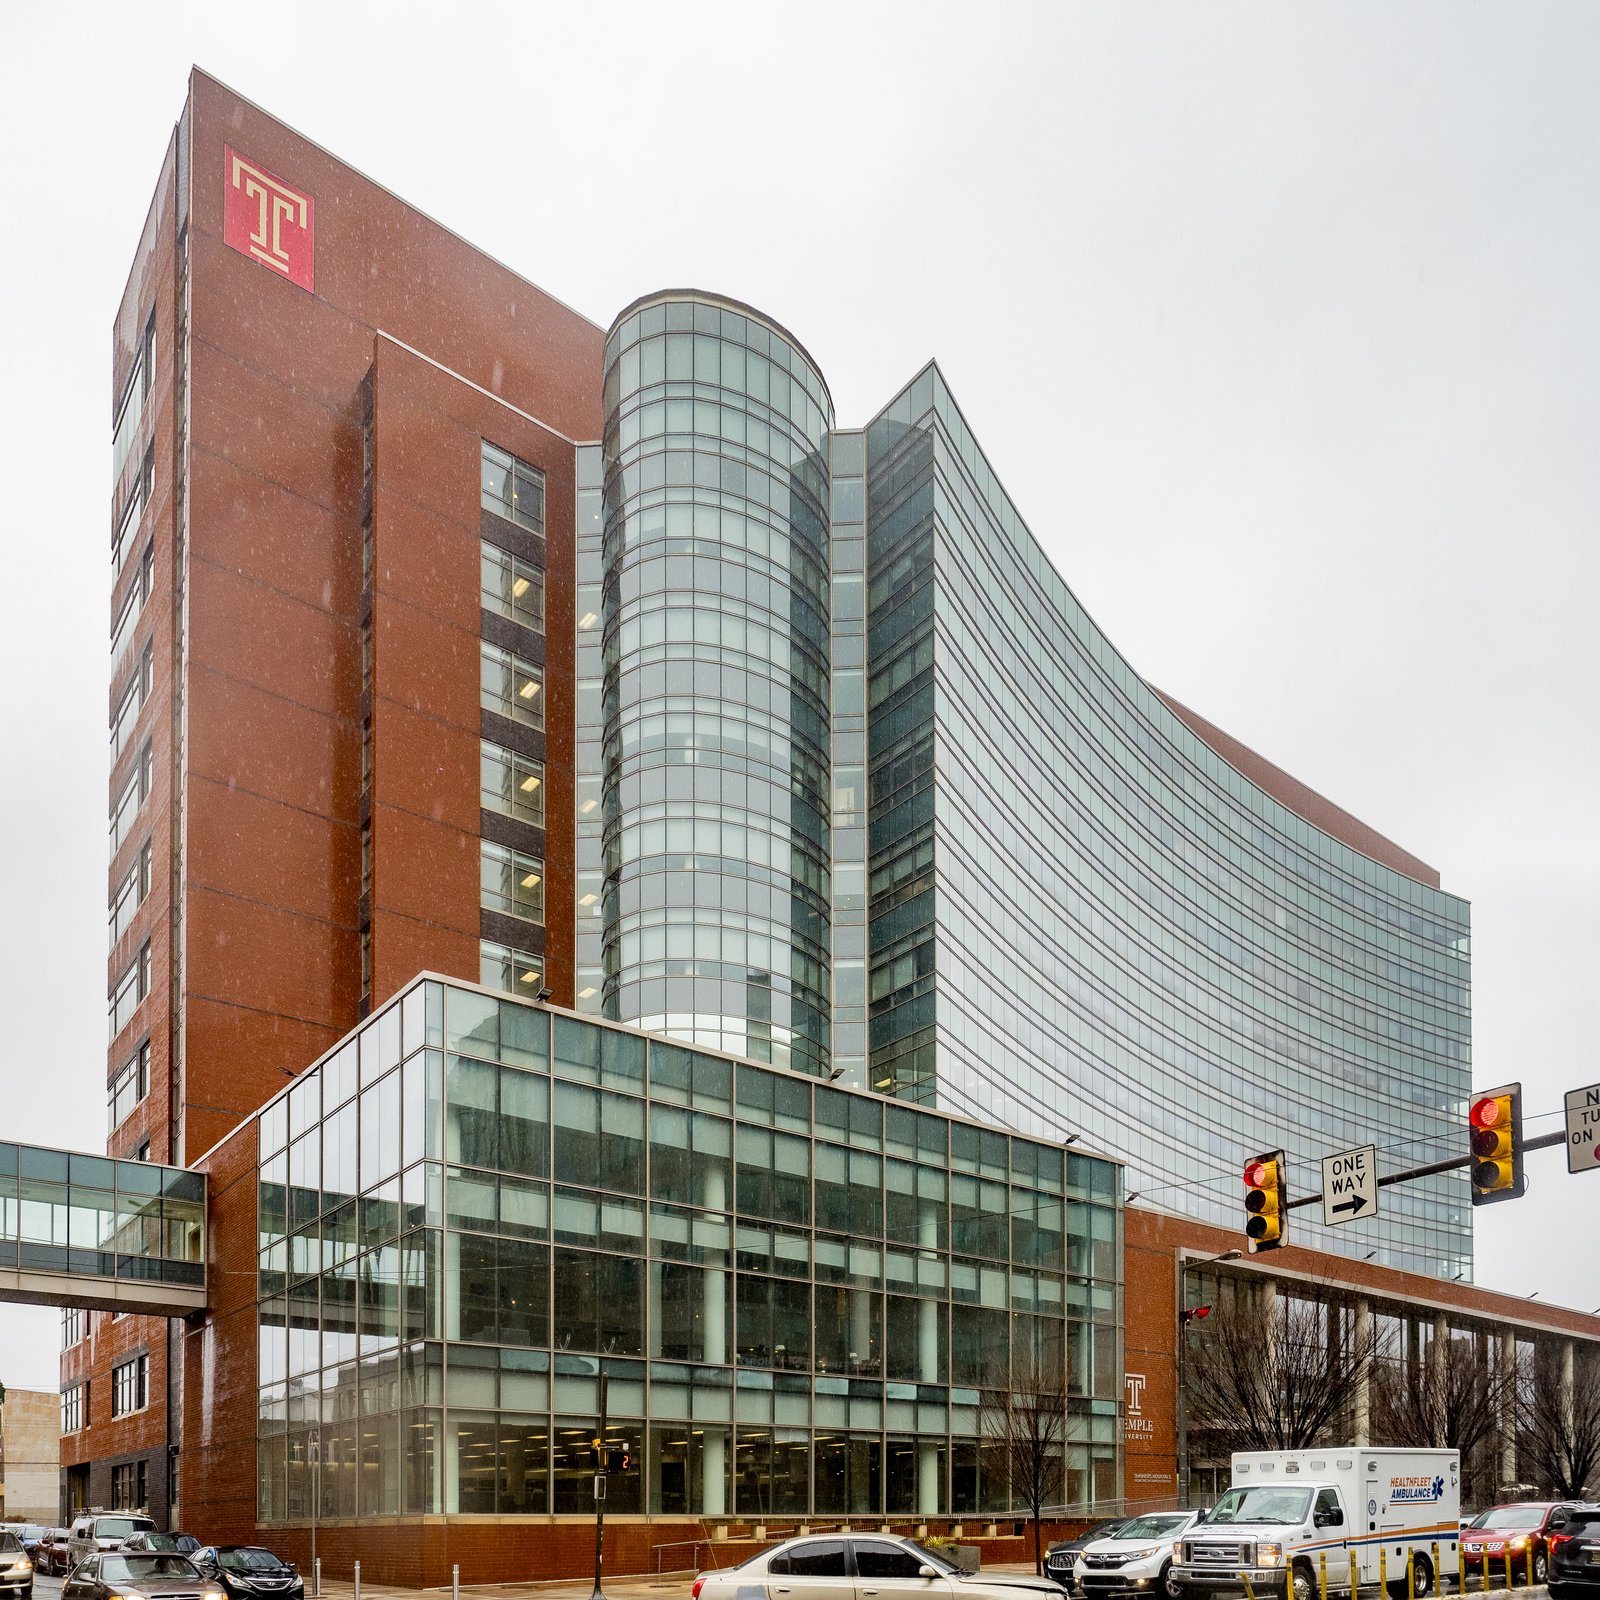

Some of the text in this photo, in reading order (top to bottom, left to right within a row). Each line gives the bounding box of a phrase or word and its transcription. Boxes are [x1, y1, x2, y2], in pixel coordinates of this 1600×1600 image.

[1586, 1088, 1600, 1107] N
[1580, 1108, 1600, 1125] TU
[1571, 1128, 1593, 1145] ON
[1332, 1153, 1365, 1176] ONE
[1331, 1171, 1367, 1195] WAY
[1124, 1418, 1154, 1432] EMPLE
[622, 1455, 629, 1469] 2
[1390, 1476, 1432, 1487] HEALTHFLEET
[1390, 1488, 1431, 1499] AMBULANCE
